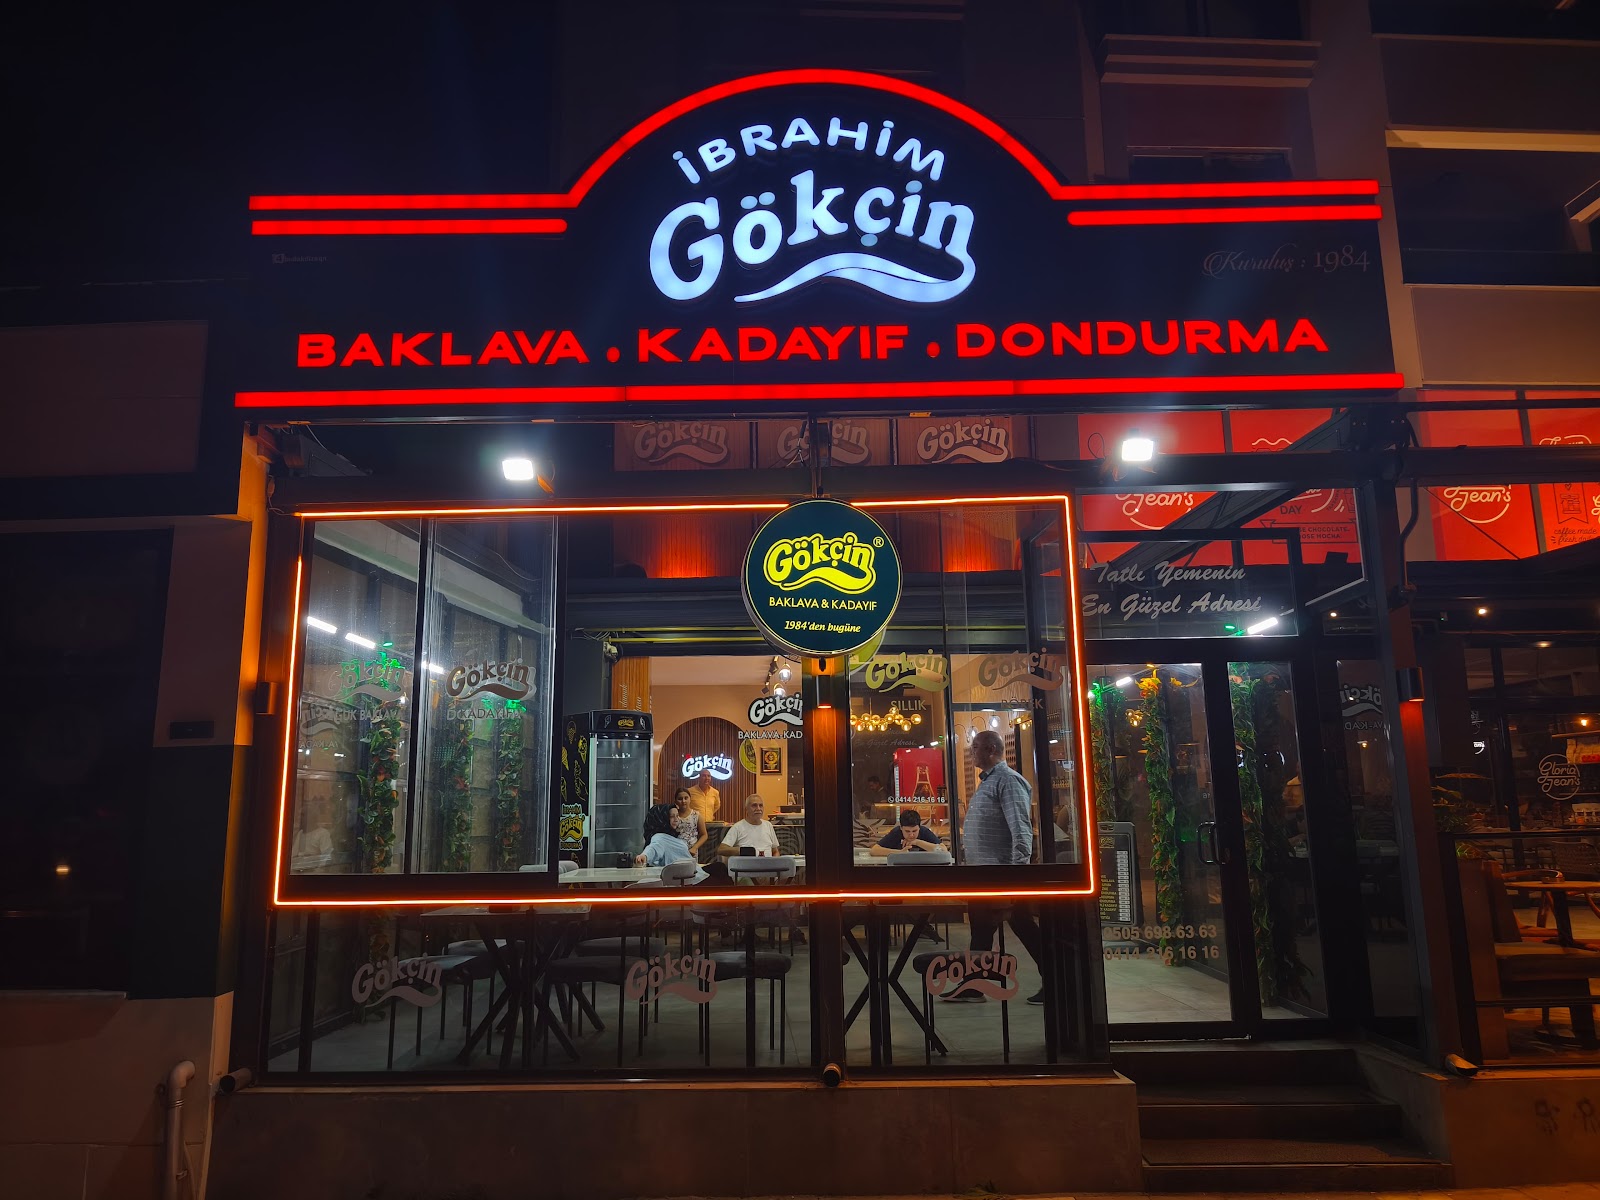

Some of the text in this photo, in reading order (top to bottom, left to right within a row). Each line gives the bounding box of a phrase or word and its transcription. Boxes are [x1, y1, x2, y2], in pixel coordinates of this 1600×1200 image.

[672, 116, 944, 184] İBRAHİM
[649, 169, 976, 302] Gökçin
[1200, 243, 1298, 279] Kuruluş
[1312, 245, 1370, 272] 1984
[297, 330, 590, 367] BAKLAVA
[638, 325, 908, 363] KADAYIF
[955, 318, 1329, 358] DONDURMA
[917, 418, 1008, 464] Gökçin
[1280, 505, 1303, 514] DAY
[763, 532, 876, 594] Gökçin
[1090, 561, 1246, 587] Tatlı Yemenin
[769, 597, 877, 610] BAKLAVA & KADAYIF
[1082, 591, 1261, 621] En Güzel Adresi
[784, 620, 861, 634] 1984'den bugüne
[446, 657, 535, 701] Gökçin
[865, 648, 950, 692] Gökçin
[979, 647, 1063, 691] Gökçin
[682, 752, 734, 780] Gökçin
[1539, 761, 1577, 779] Gloria
[1541, 777, 1580, 793] Jean's
[1103, 924, 1217, 940] 0505 698 63 63
[926, 945, 1019, 1000] Gökçin
[1104, 945, 1219, 960] 0414 216 16 16
[352, 952, 443, 1007] Gökçin
[625, 948, 718, 1004] Gökçin
